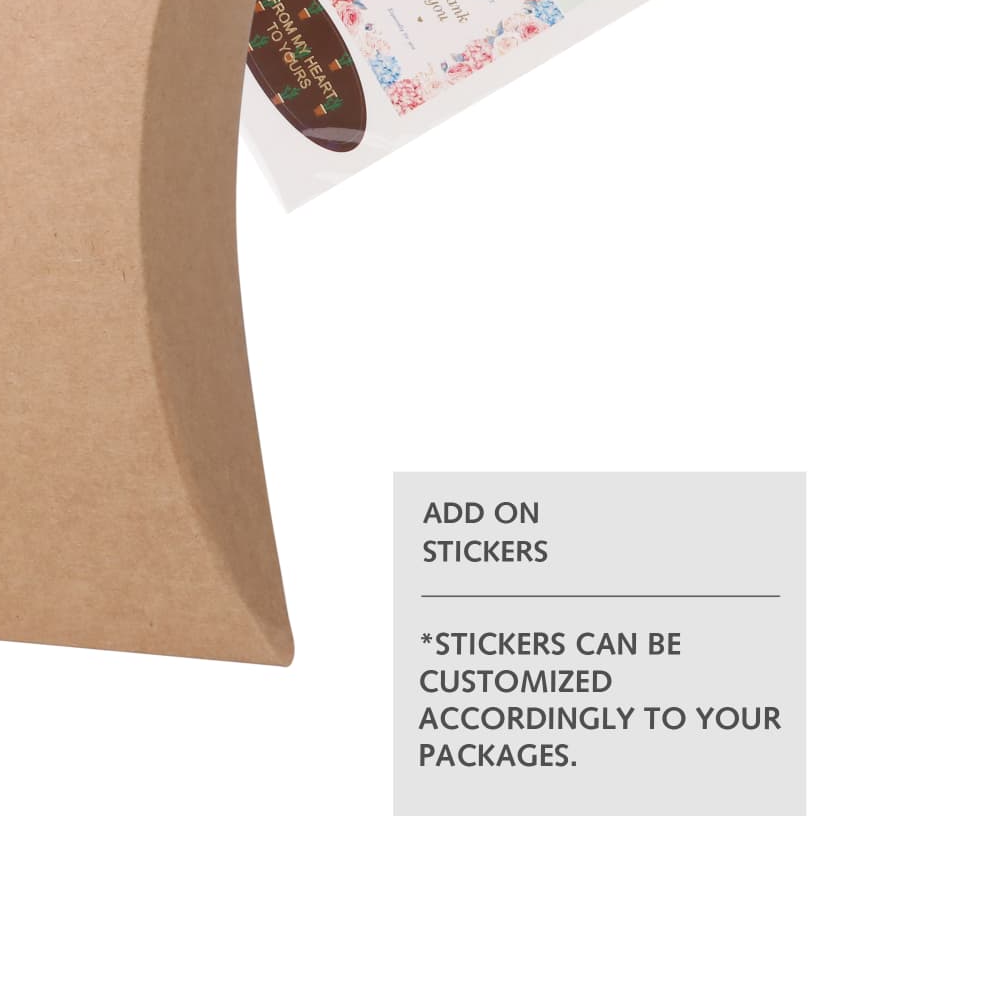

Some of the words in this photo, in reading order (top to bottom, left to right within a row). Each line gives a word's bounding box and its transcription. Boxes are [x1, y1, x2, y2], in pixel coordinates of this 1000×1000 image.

[265, 22, 284, 42] TO
[278, 43, 313, 91] YOURS
[290, 34, 313, 56] MY
[303, 55, 339, 101] HEART
